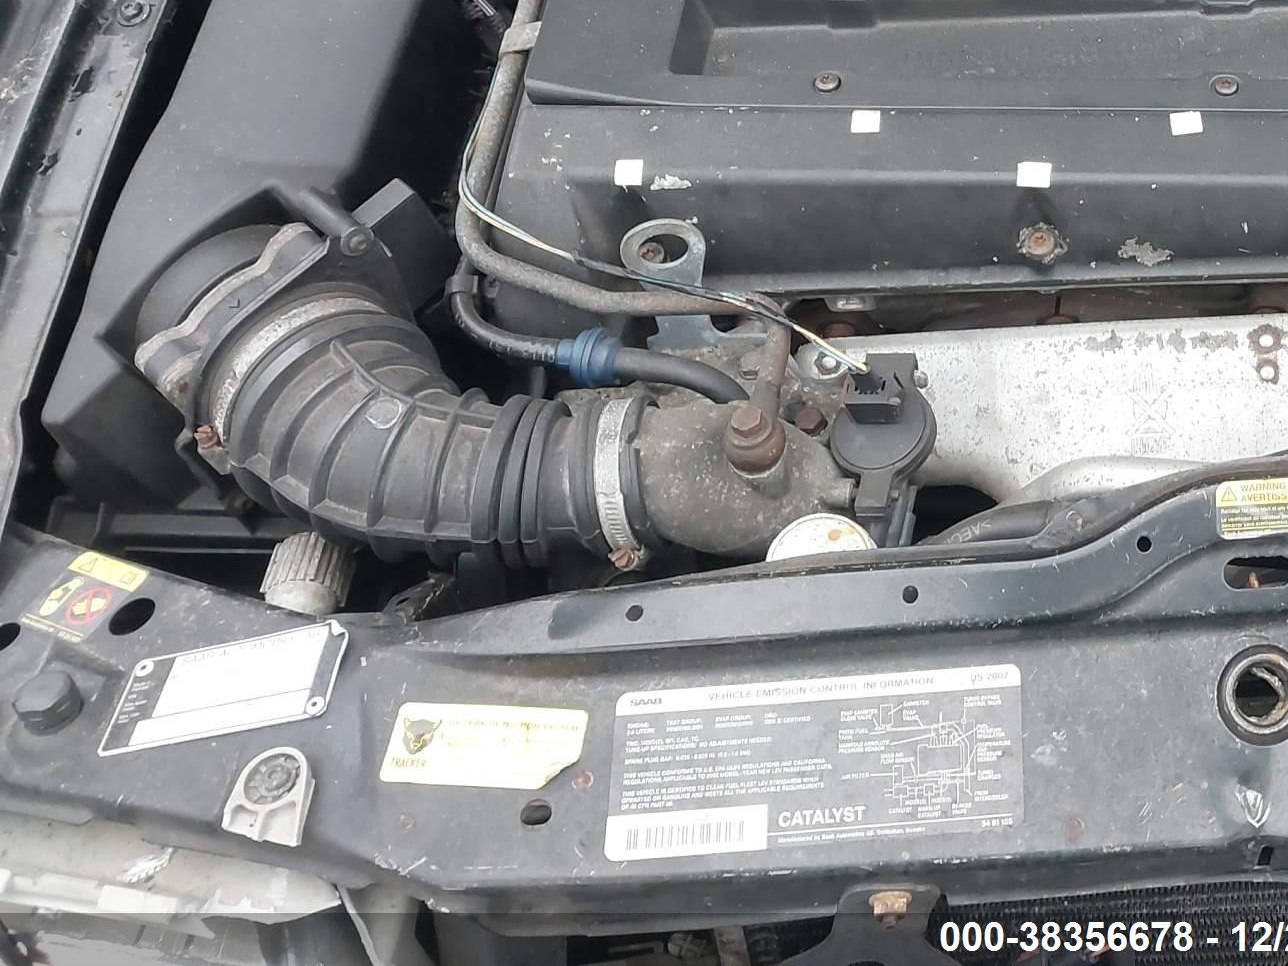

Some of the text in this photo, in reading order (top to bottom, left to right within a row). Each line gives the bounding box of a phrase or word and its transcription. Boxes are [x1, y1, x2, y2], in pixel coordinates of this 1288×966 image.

[1240, 482, 1287, 493] WARNING
[708, 677, 934, 701] VEHICLE EMISSION CONTROL INFORMATION
[630, 697, 663, 707] SAAB
[391, 756, 427, 768] TRACKER
[778, 805, 867, 829] CATALYST
